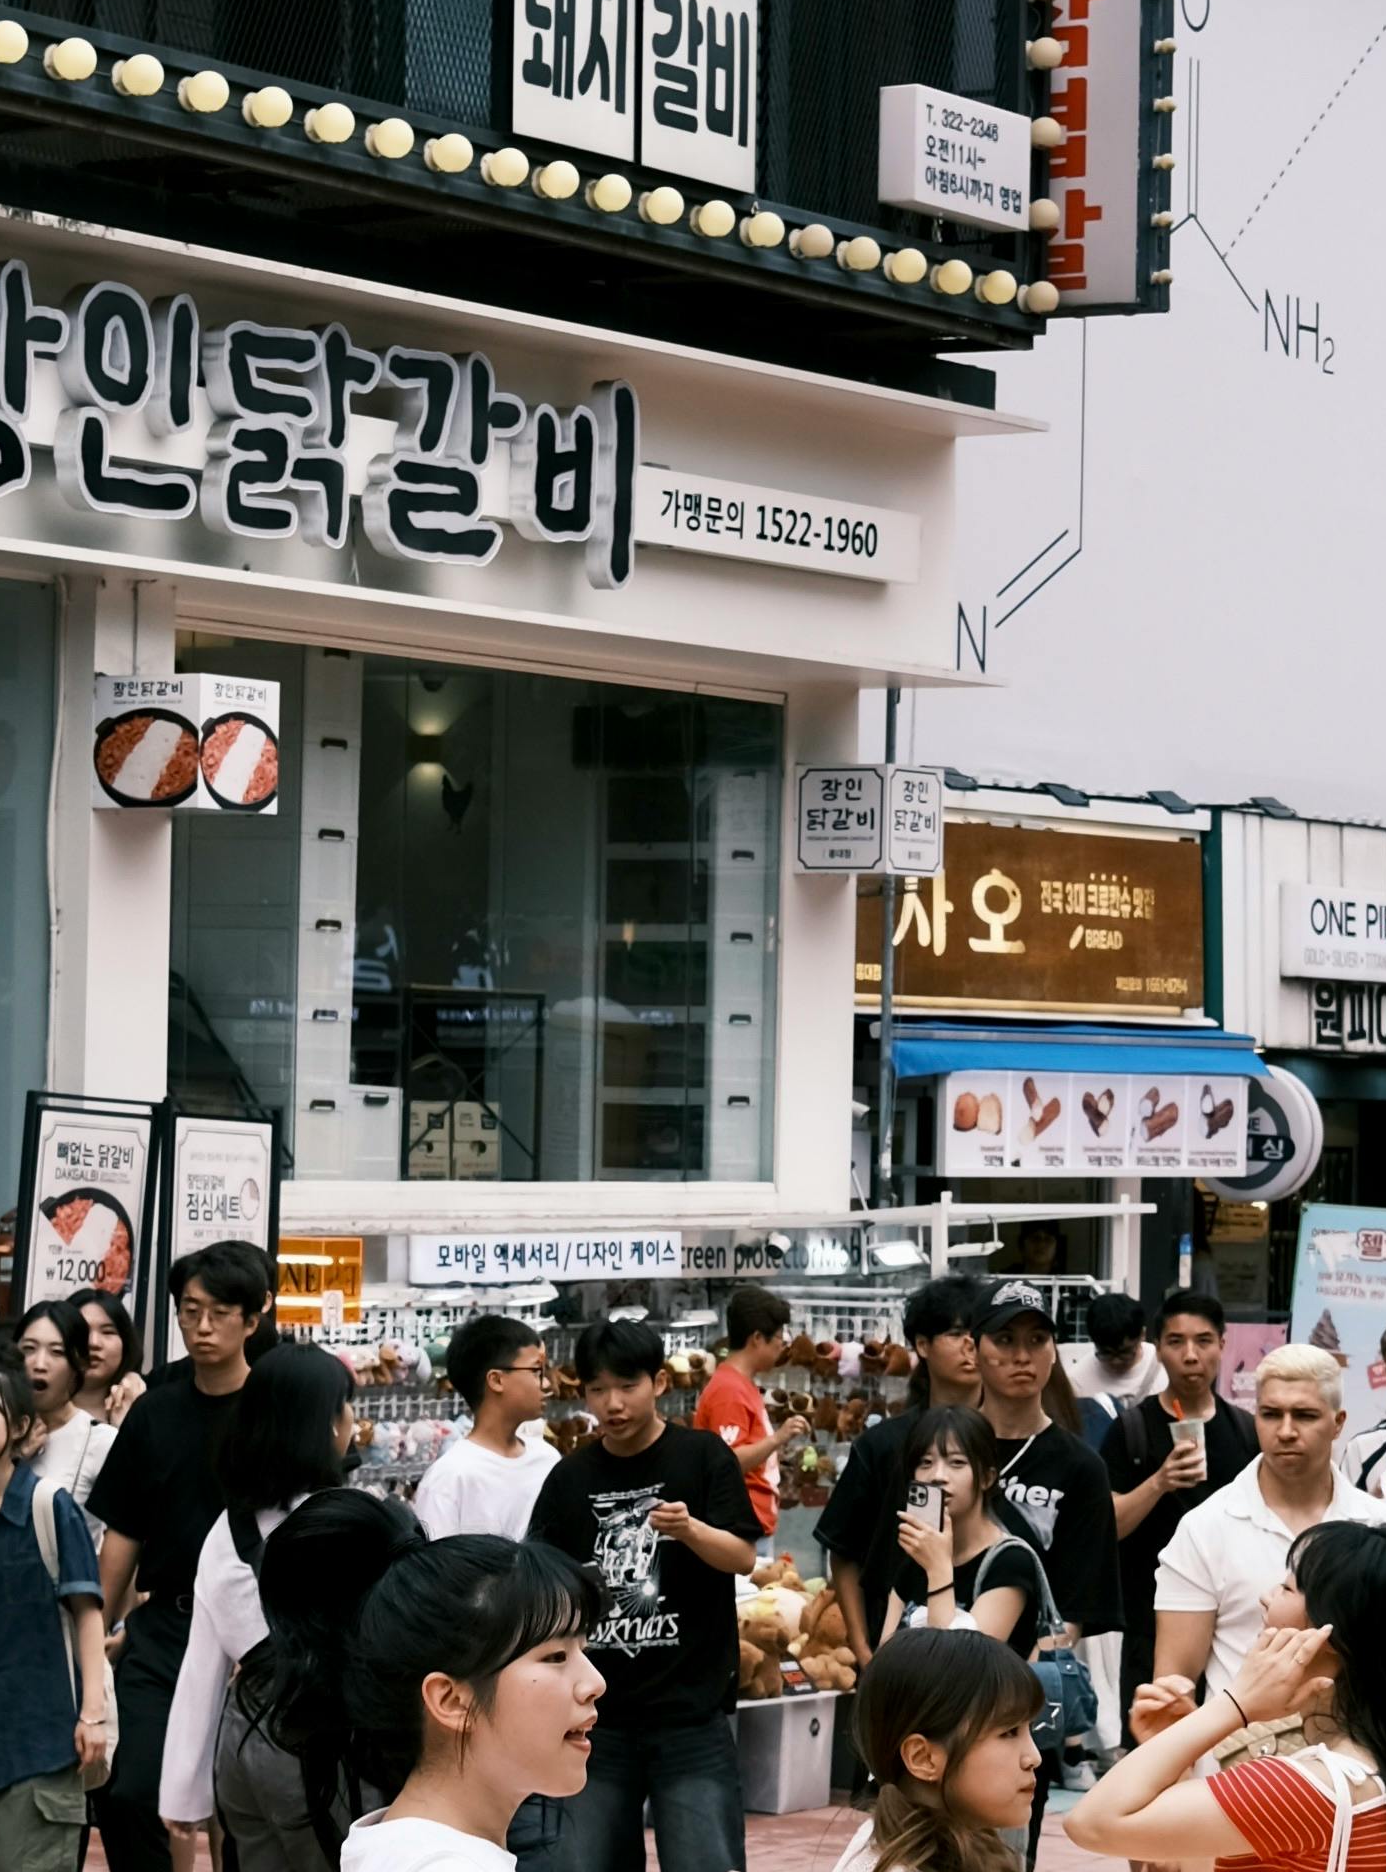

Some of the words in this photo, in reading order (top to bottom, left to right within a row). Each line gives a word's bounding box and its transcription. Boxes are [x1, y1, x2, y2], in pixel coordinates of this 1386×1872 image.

[925, 103, 937, 126] T.
[659, 485, 747, 543] 가맹문의
[755, 502, 880, 561] 1522-1960
[956, 601, 987, 674] N
[113, 680, 184, 698] 장인닭갈비
[820, 777, 863, 801] 장인
[903, 779, 929, 805] 장인
[806, 806, 876, 831] 닭갈비
[893, 808, 937, 835] 닭갈비
[1040, 880, 1063, 915] 전국
[1065, 881, 1086, 916] 3대
[1310, 898, 1357, 937] ONE
[1084, 928, 1124, 951] BREAD
[1303, 947, 1326, 966] GOLD
[1331, 949, 1360, 969] SILVER
[98, 1144, 135, 1170] 닭갈비
[54, 1166, 100, 1182] DAKGALBI
[185, 1192, 241, 1222] 점심세트
[436, 1244, 487, 1274] 모바일
[493, 1242, 560, 1274] 액세서리
[575, 1240, 623, 1271] 디자인
[629, 1239, 676, 1267] 케이스
